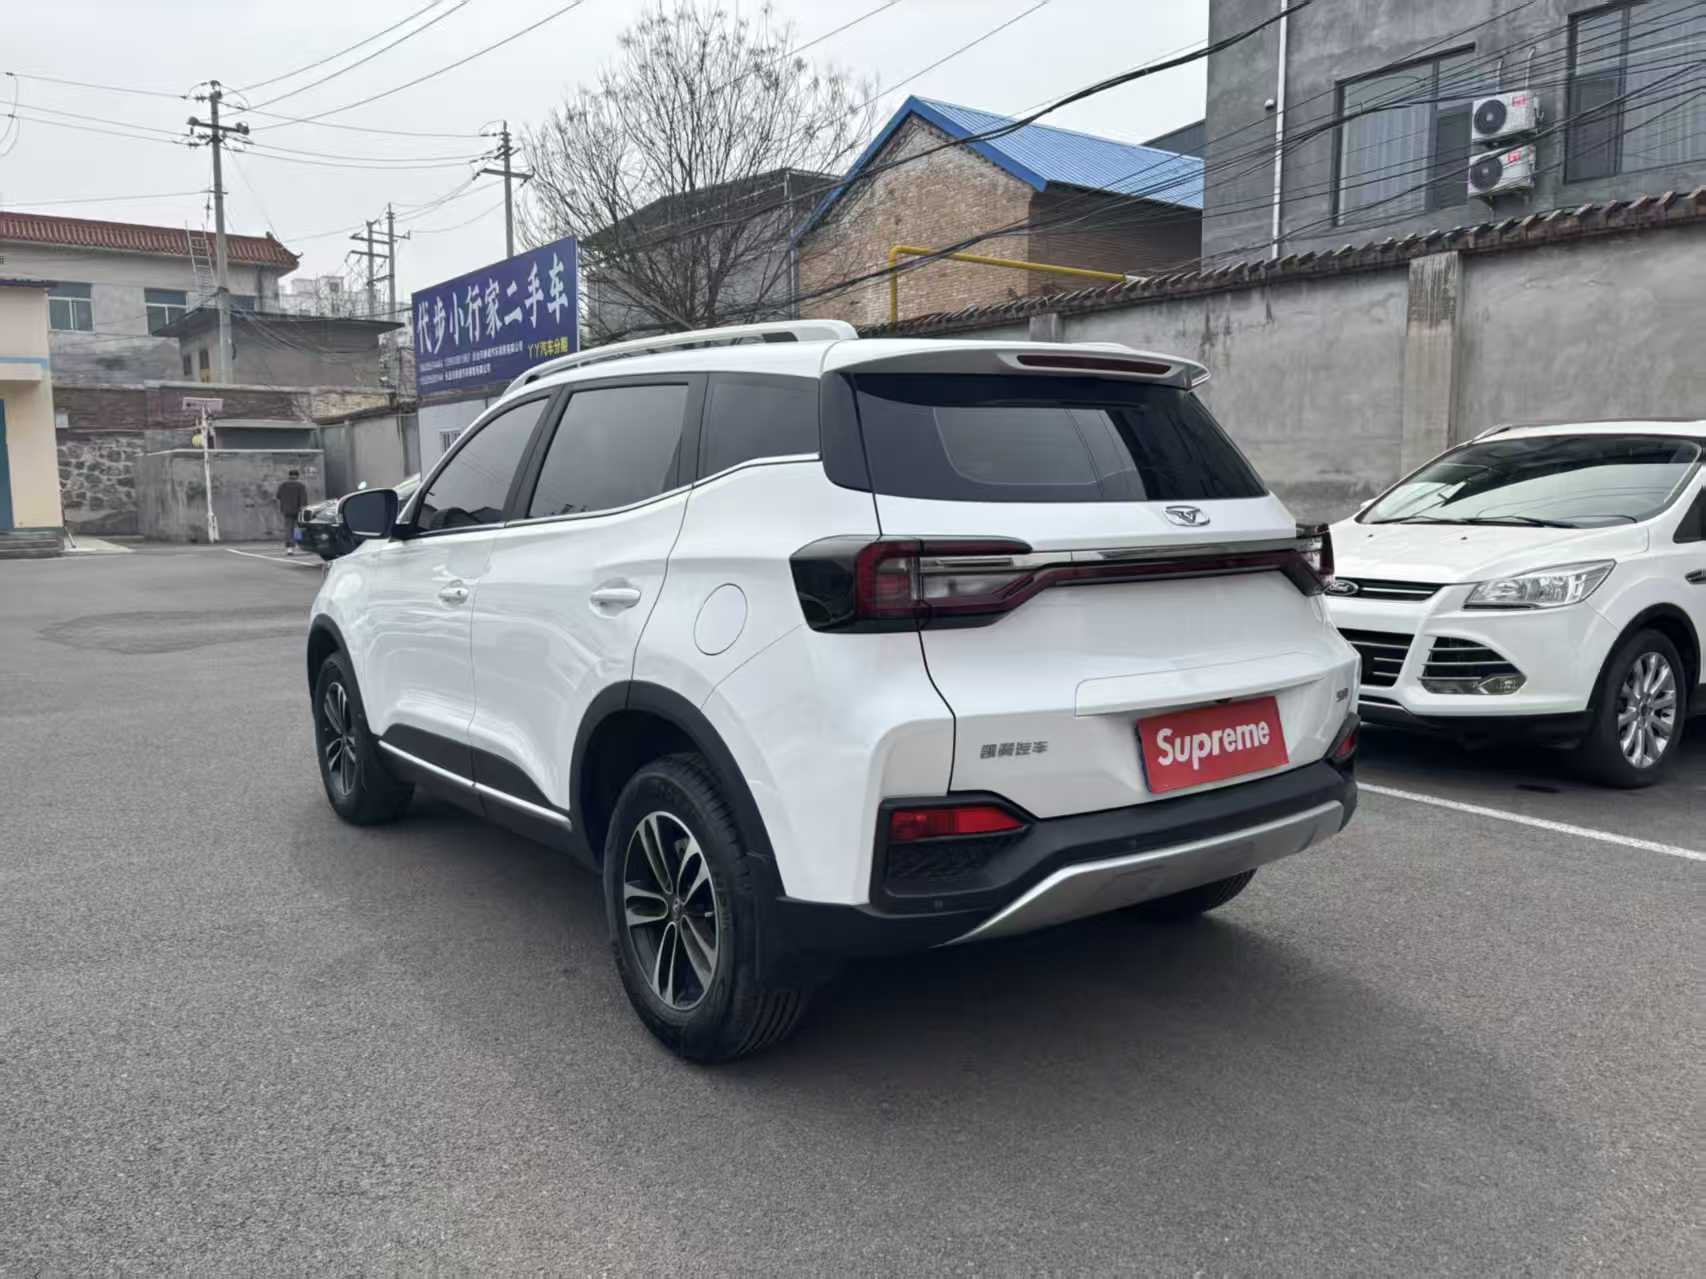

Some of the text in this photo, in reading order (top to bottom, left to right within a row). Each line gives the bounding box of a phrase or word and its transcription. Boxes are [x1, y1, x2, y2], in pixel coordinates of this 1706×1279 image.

[417, 252, 568, 354] 代步小行家二手车
[1156, 720, 1270, 771] Supreme
